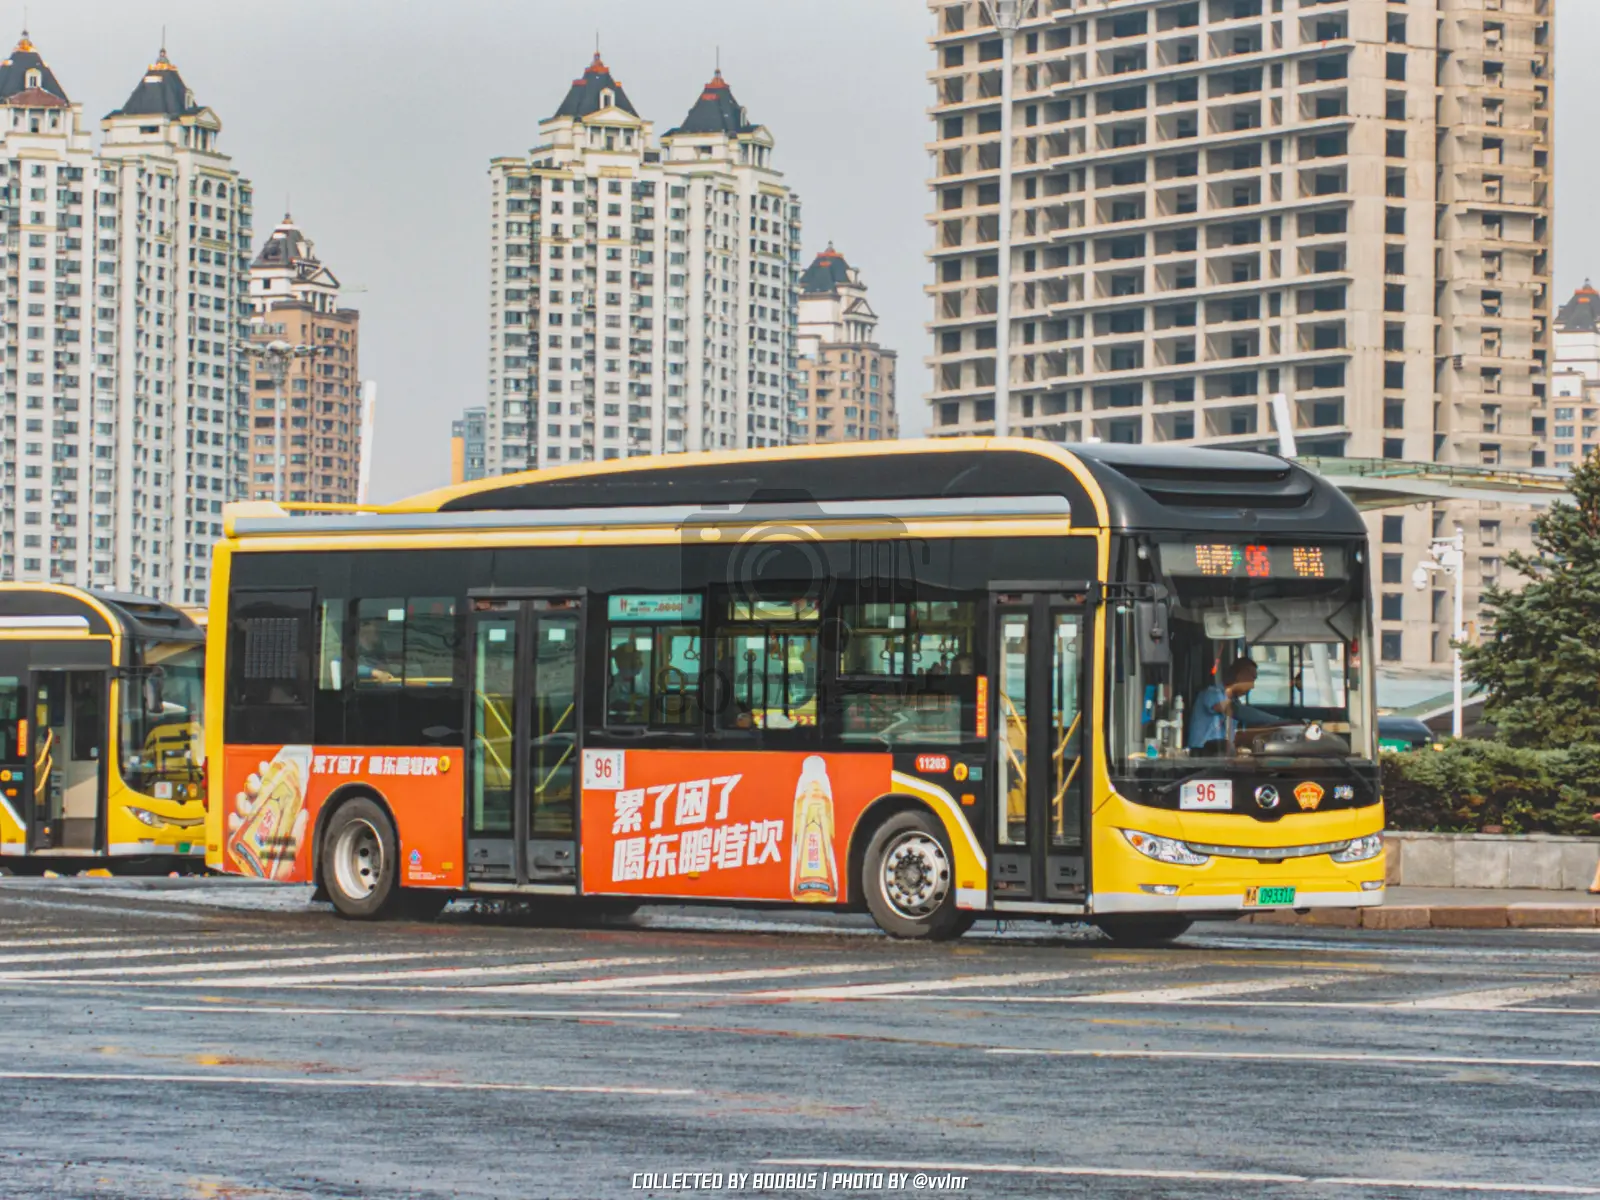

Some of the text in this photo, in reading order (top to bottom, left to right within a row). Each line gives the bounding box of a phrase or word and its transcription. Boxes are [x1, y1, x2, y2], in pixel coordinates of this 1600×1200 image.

[1245, 544, 1270, 577] 96
[595, 758, 612, 778] 96
[611, 774, 743, 834] 累了困了
[1196, 783, 1216, 802] 96
[611, 819, 784, 882] 喝东鹏特饮
